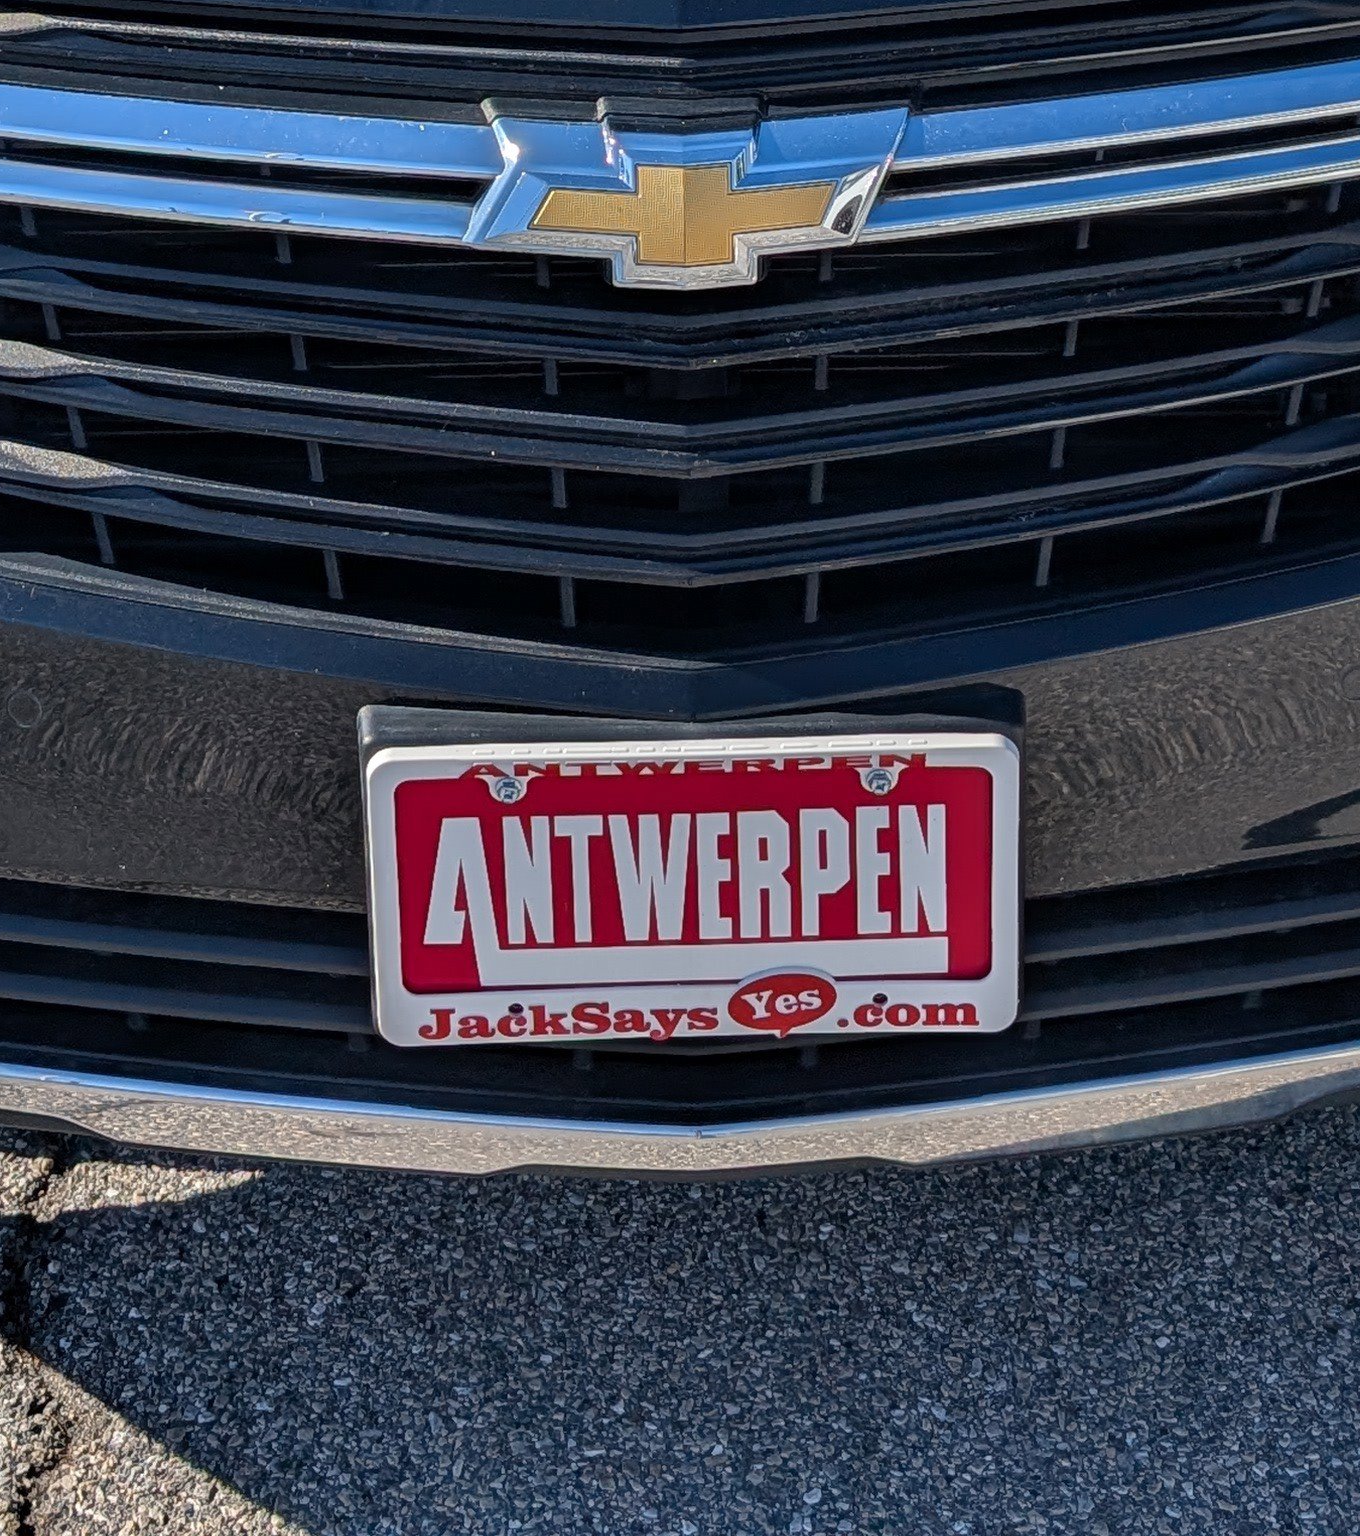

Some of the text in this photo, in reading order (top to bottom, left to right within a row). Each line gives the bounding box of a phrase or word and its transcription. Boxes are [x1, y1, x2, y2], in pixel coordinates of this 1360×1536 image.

[458, 752, 928, 779] ANTWERPEN
[422, 802, 950, 948] ANTWERPEN
[416, 984, 980, 1041] JackSays Yes .com
